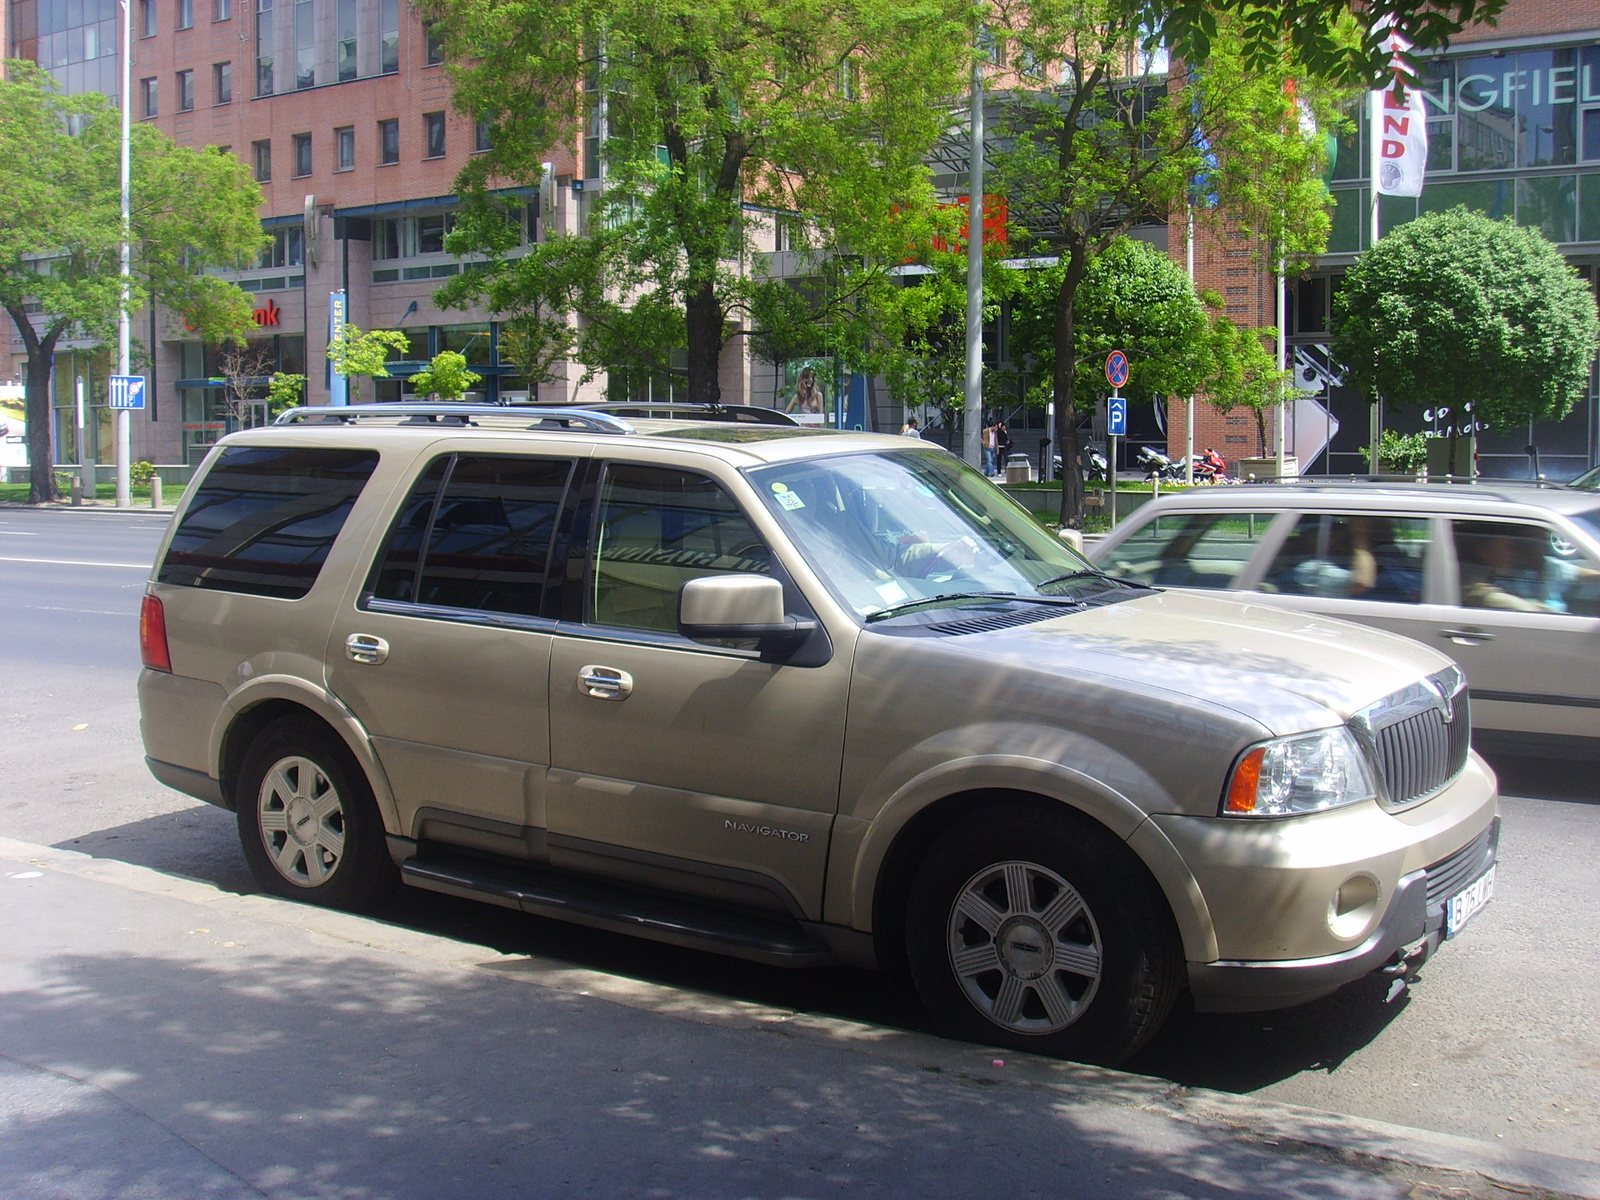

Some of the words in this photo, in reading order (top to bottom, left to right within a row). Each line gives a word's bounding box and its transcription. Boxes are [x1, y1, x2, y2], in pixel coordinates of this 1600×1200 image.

[1111, 411, 1122, 430] P
[724, 820, 809, 843] NAVIGATOR
[1455, 897, 1463, 925] B
